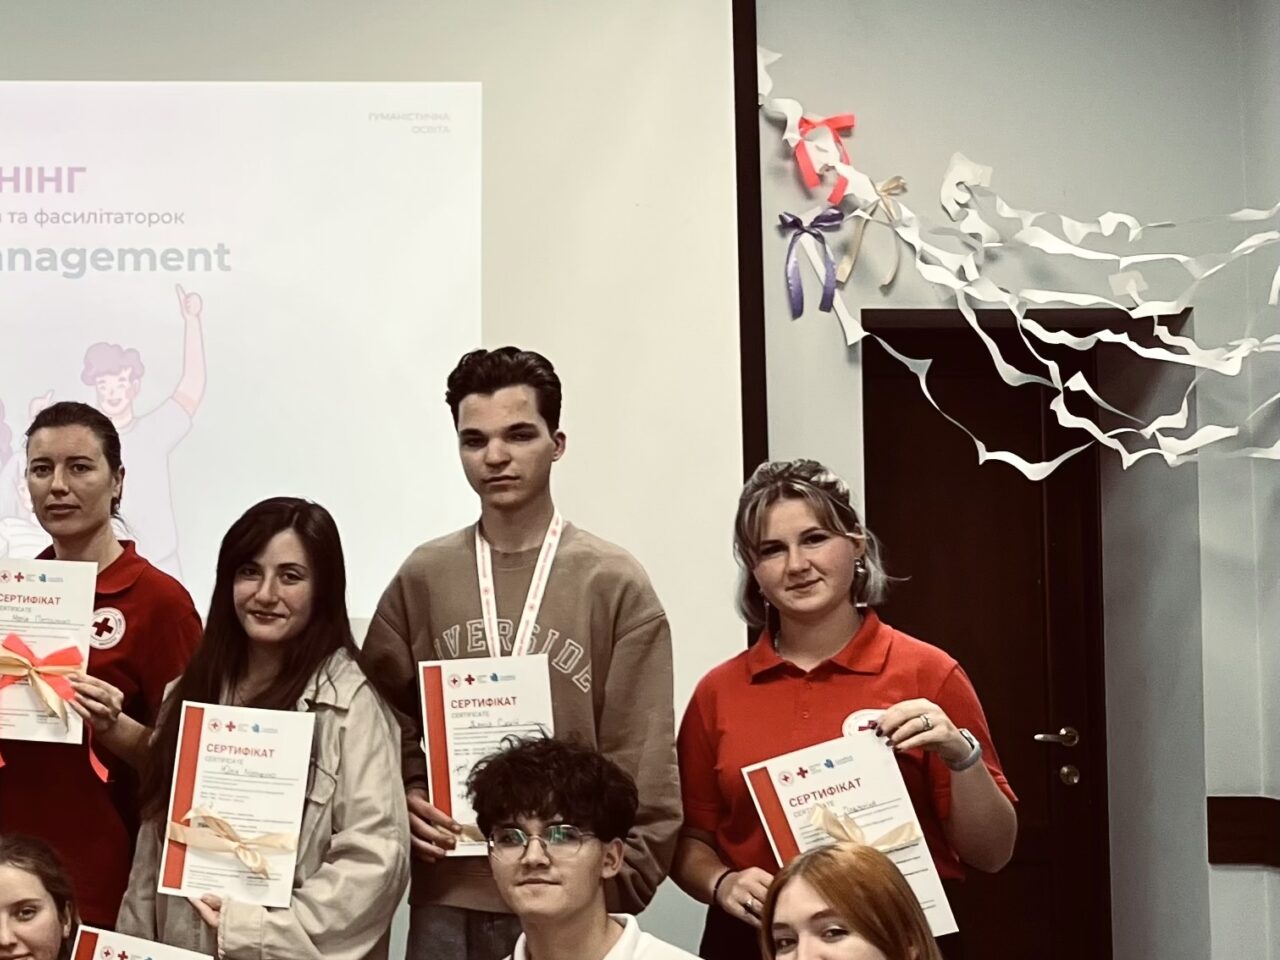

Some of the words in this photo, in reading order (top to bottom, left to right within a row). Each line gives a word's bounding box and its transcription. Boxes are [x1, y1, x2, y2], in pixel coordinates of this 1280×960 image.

[8, 211, 29, 225] та
[34, 208, 185, 228] фасилітаторок
[451, 696, 517, 709] СЕРТИФІКАТ
[206, 743, 276, 758] СЕРТИФІКАТ
[789, 777, 862, 808] СЕРТИФІКАТ
